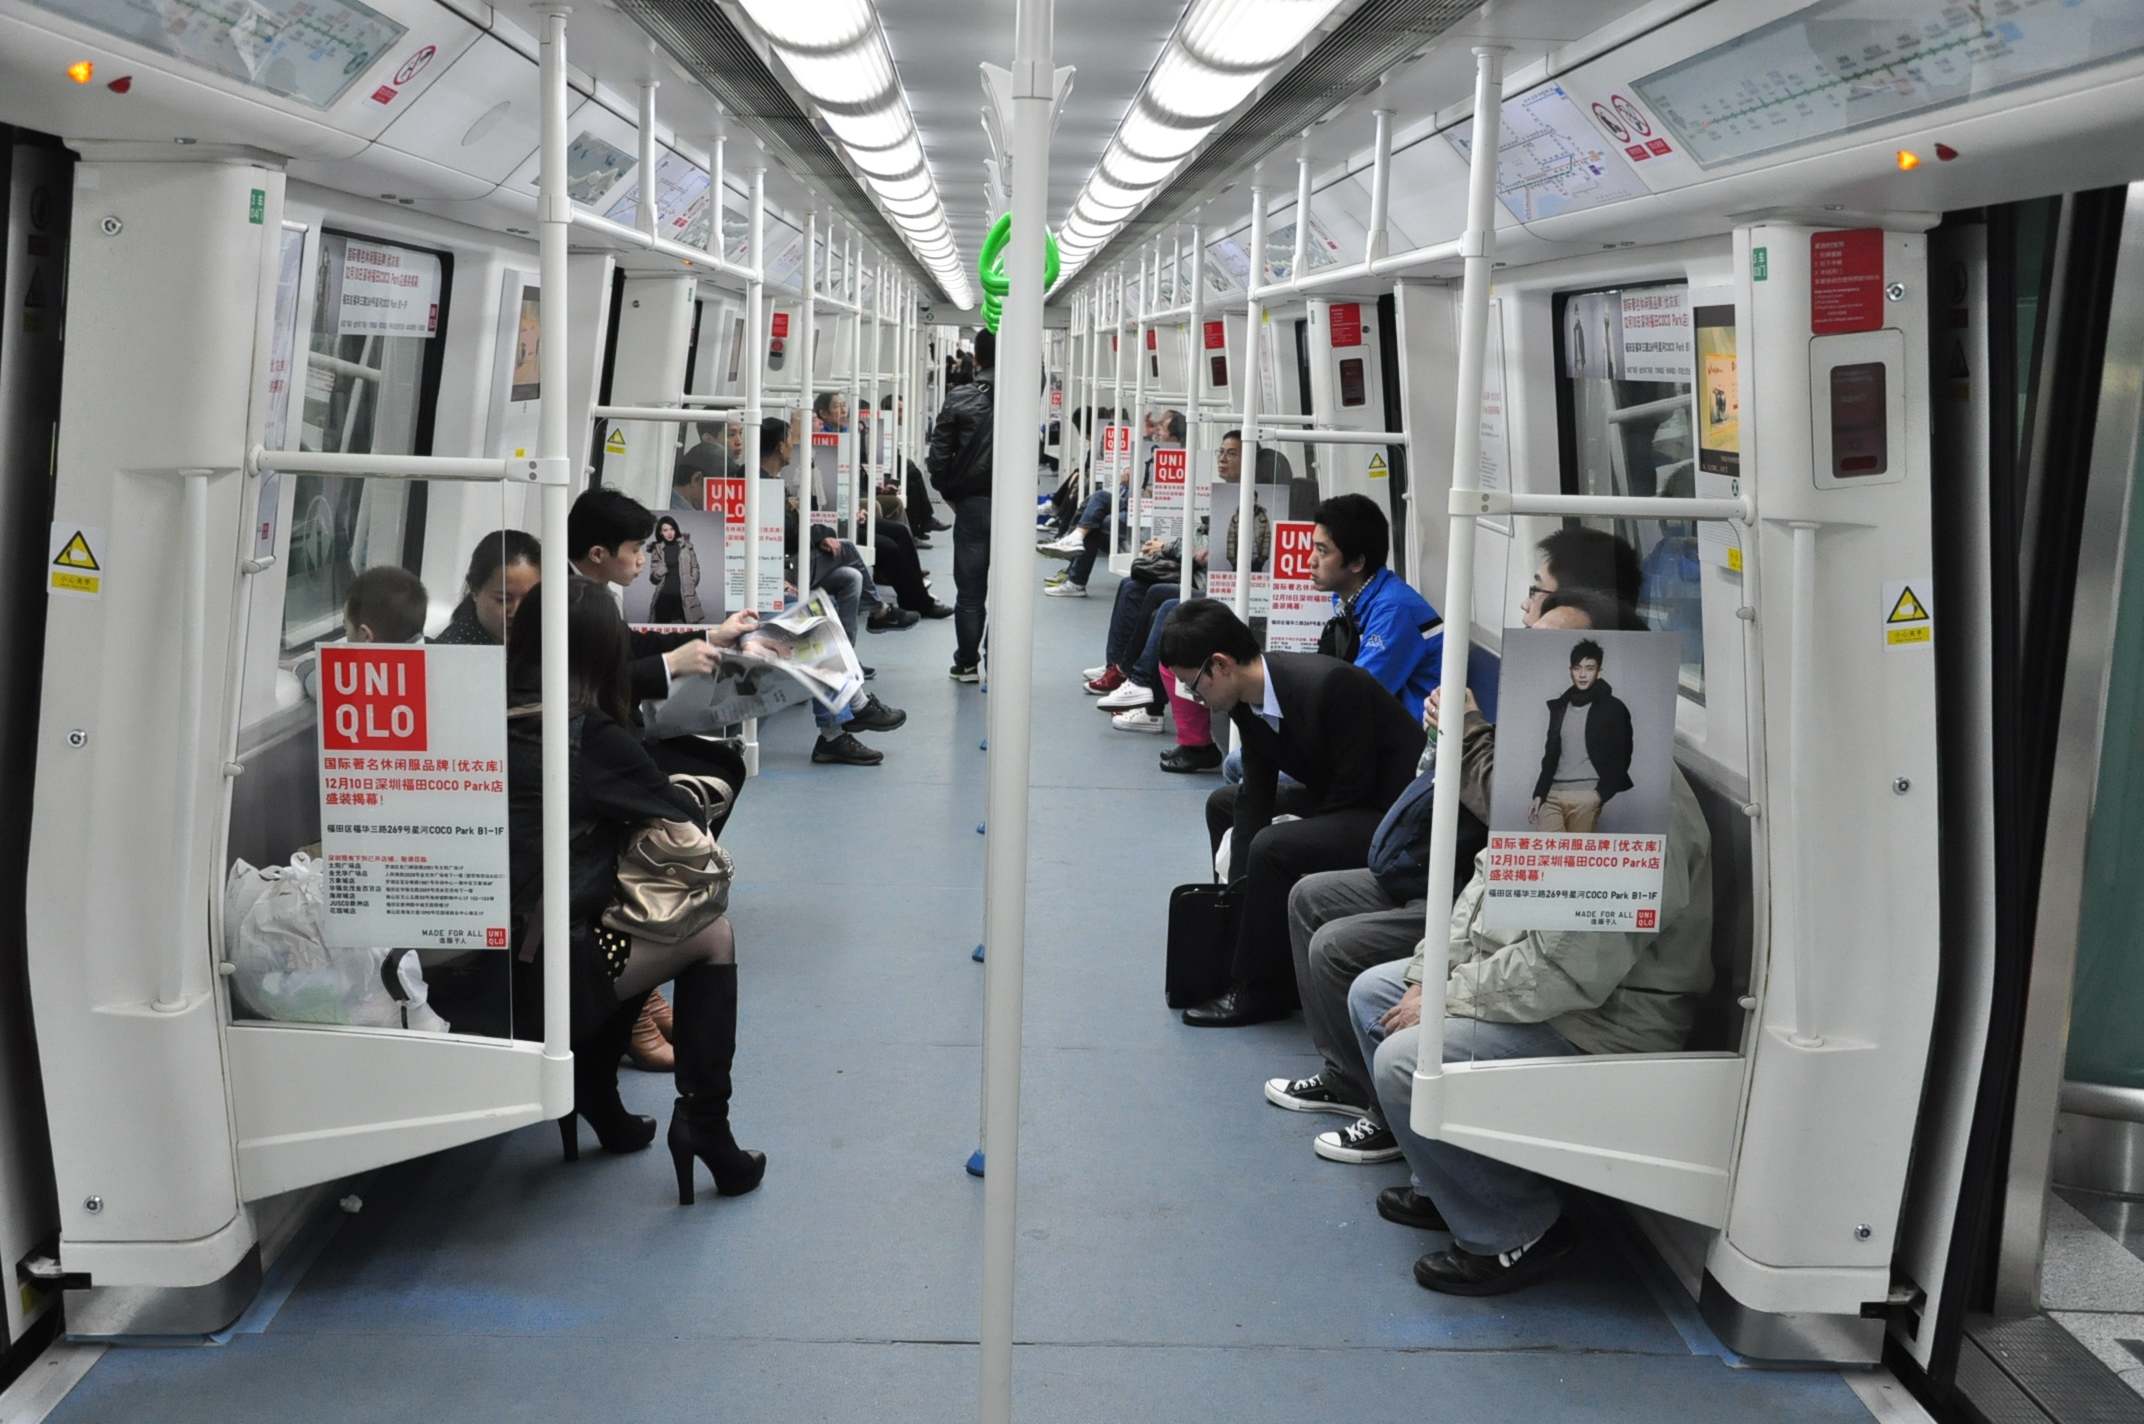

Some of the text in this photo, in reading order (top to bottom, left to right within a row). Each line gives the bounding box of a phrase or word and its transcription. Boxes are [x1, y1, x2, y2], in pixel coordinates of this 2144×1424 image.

[1159, 454, 1182, 466] UNI
[1158, 468, 1184, 481] QLO
[712, 484, 742, 500] UNI
[1282, 531, 1312, 550] UN
[1280, 554, 1312, 576] QL
[333, 662, 406, 697] UNI
[335, 704, 415, 743] QLO
[325, 777, 503, 792] 12月10日深圳福田COCO Park店
[326, 793, 384, 805] 盛装揭幕!
[456, 827, 474, 835] Park
[478, 827, 504, 835] B1-1F
[1490, 855, 1660, 870] 12月10日深圳福田COCO Park店
[1489, 870, 1545, 882] 盛装揭幕!
[1611, 891, 1629, 900] Park
[1632, 891, 1658, 900] B1-1F
